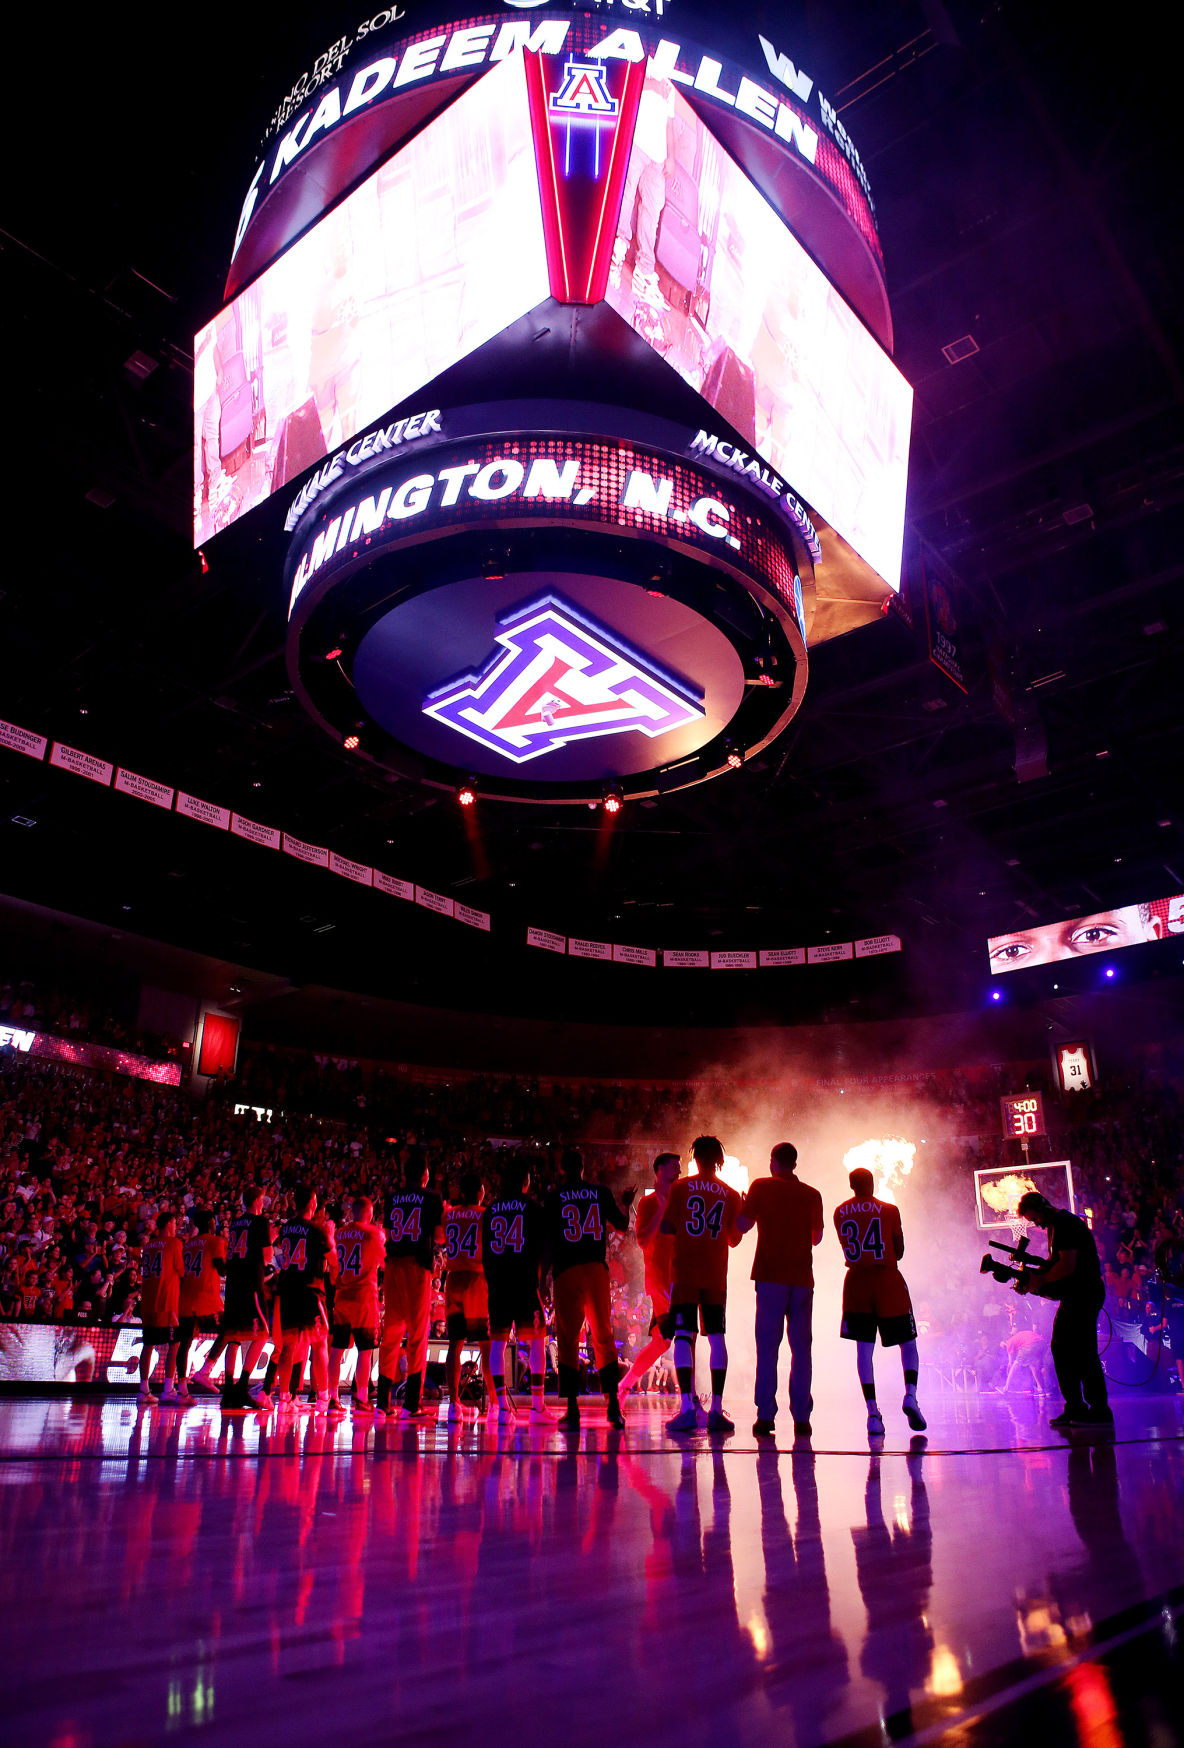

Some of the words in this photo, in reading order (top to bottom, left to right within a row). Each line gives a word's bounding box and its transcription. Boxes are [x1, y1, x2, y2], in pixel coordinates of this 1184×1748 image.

[312, 35, 353, 78] DEL
[356, 4, 405, 41] SOL
[276, 49, 350, 134] RESORT
[549, 62, 619, 116] A
[269, 20, 571, 185] KADEEM
[585, 28, 818, 165] ALLEN
[345, 409, 444, 466] CENTER
[690, 430, 784, 498] MCKALE
[622, 470, 741, 551] N.C.
[10, 726, 42, 745] BUDINGER
[60, 746, 84, 760] GILBERT
[84, 755, 106, 770] ARENAS
[60, 755, 104, 775] M-BASKETBALL
[120, 770, 137, 782] SALIM
[137, 777, 171, 796] STOUDAMIRE
[124, 780, 164, 800] M-BASKETBALL
[184, 803, 222, 822] M-BASKETBALL
[187, 796, 200, 807] LUKE
[200, 801, 221, 815] WALTON
[237, 817, 251, 828] JASON
[251, 823, 275, 836] GARDNER
[1070, 1064, 1082, 1076] 31
[1013, 1099, 1037, 1113] 4:00
[1013, 1112, 1036, 1135] 30
[392, 1192, 424, 1206] SIMON
[559, 1188, 599, 1202] SIMON
[687, 1179, 729, 1198] SIMON
[446, 1208, 482, 1220] SIMON
[490, 1199, 527, 1214] SIMON
[684, 1194, 726, 1240] 34
[839, 1201, 883, 1218] SIMON
[282, 1225, 309, 1236] SIMON
[390, 1206, 422, 1242] 34
[490, 1214, 525, 1254] 34
[561, 1203, 603, 1242] 34
[336, 1230, 364, 1241] SIMON
[445, 1222, 479, 1259] 34
[840, 1217, 885, 1262] 34
[281, 1238, 307, 1271] 34
[337, 1243, 362, 1278] 34
